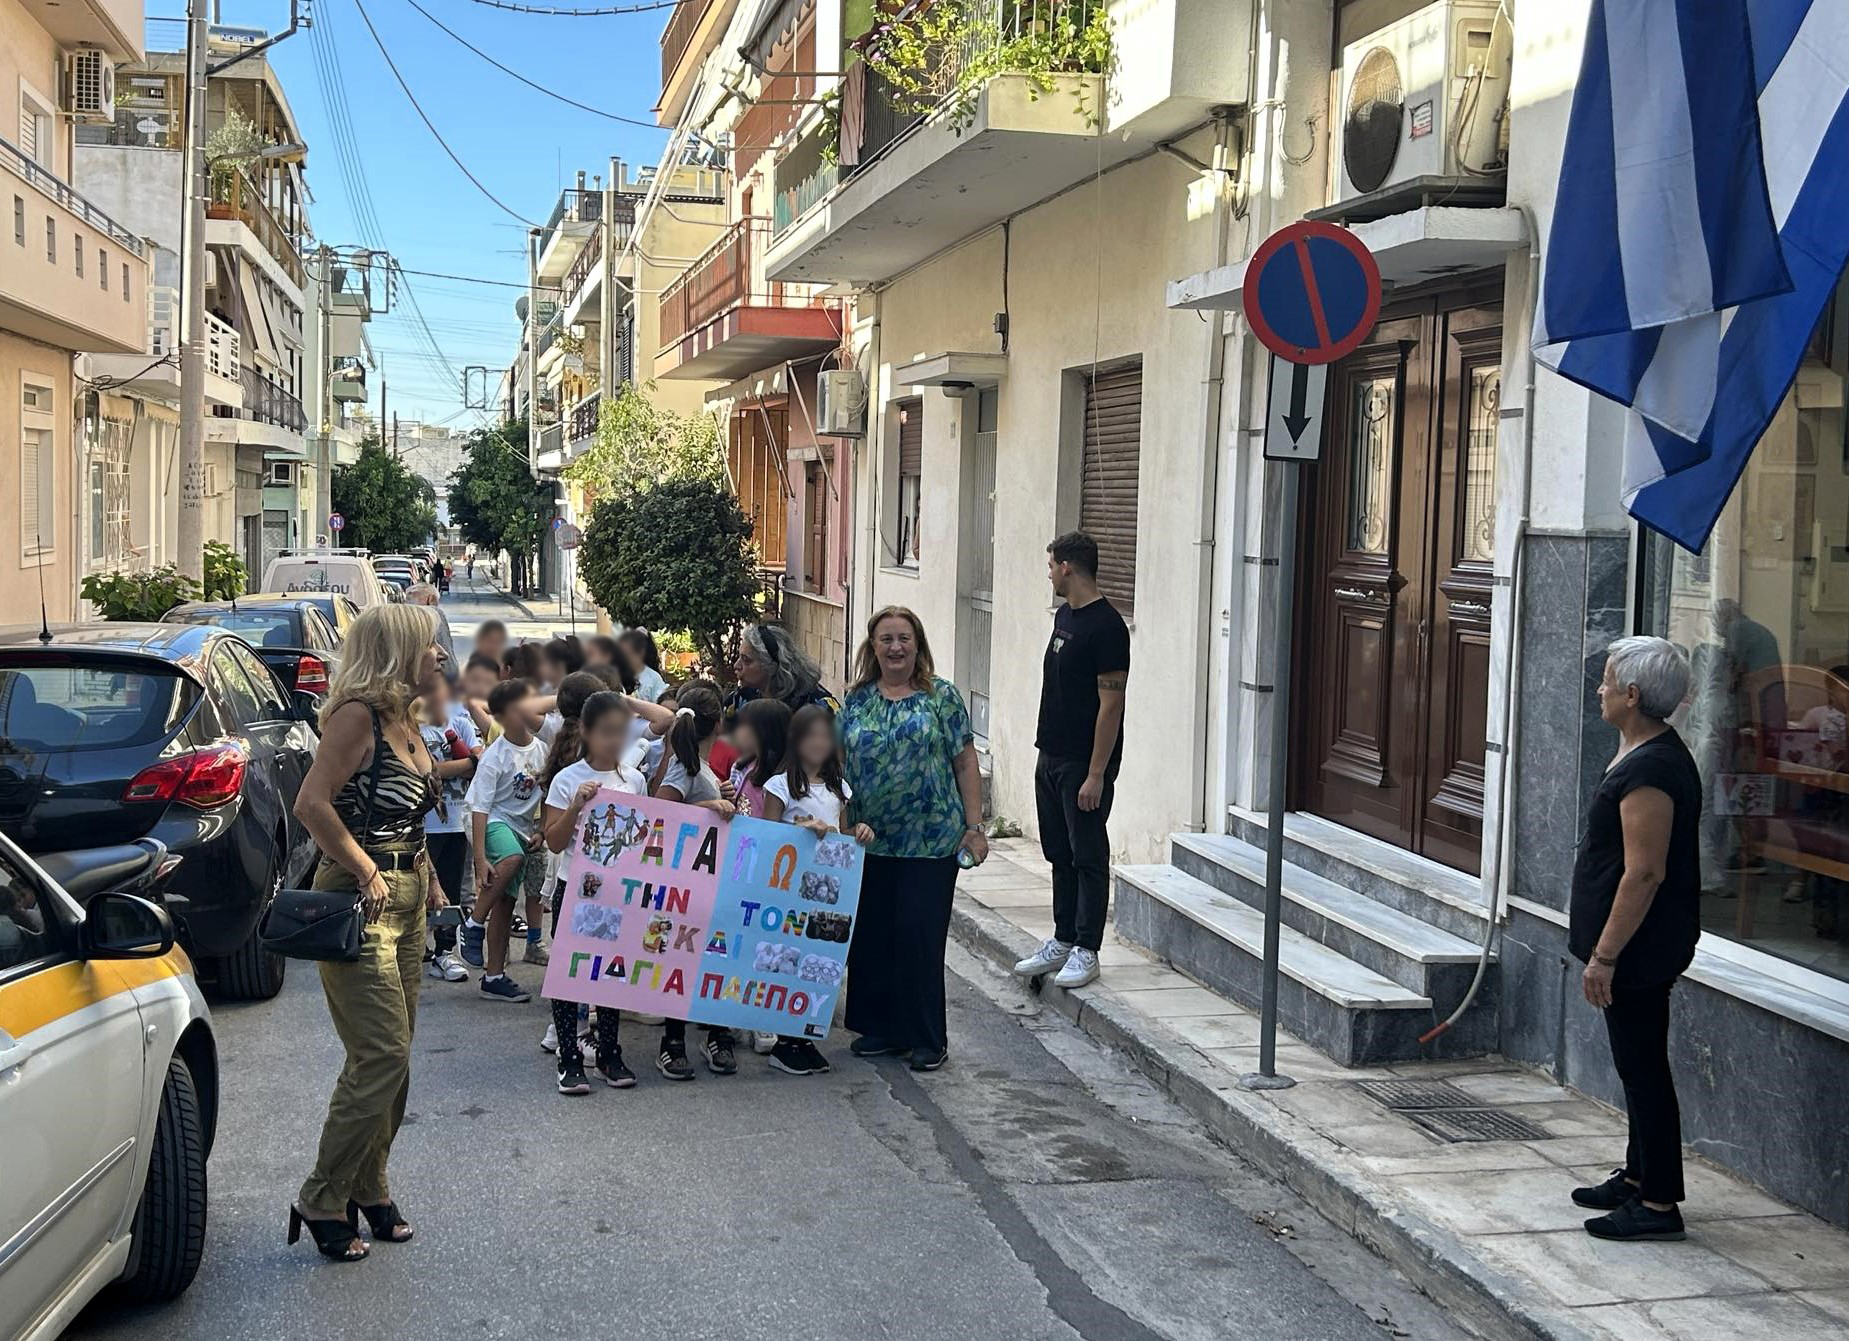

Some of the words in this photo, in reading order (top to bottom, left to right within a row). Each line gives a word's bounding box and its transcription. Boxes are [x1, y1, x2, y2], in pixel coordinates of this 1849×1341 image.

[621, 878, 691, 915] ΤΗΝ
[740, 900, 808, 937] ΤΟΝ
[568, 951, 684, 996] ΓΙΑΓΙΑ
[700, 973, 830, 1018] ΠΑΠΠΟΥ
